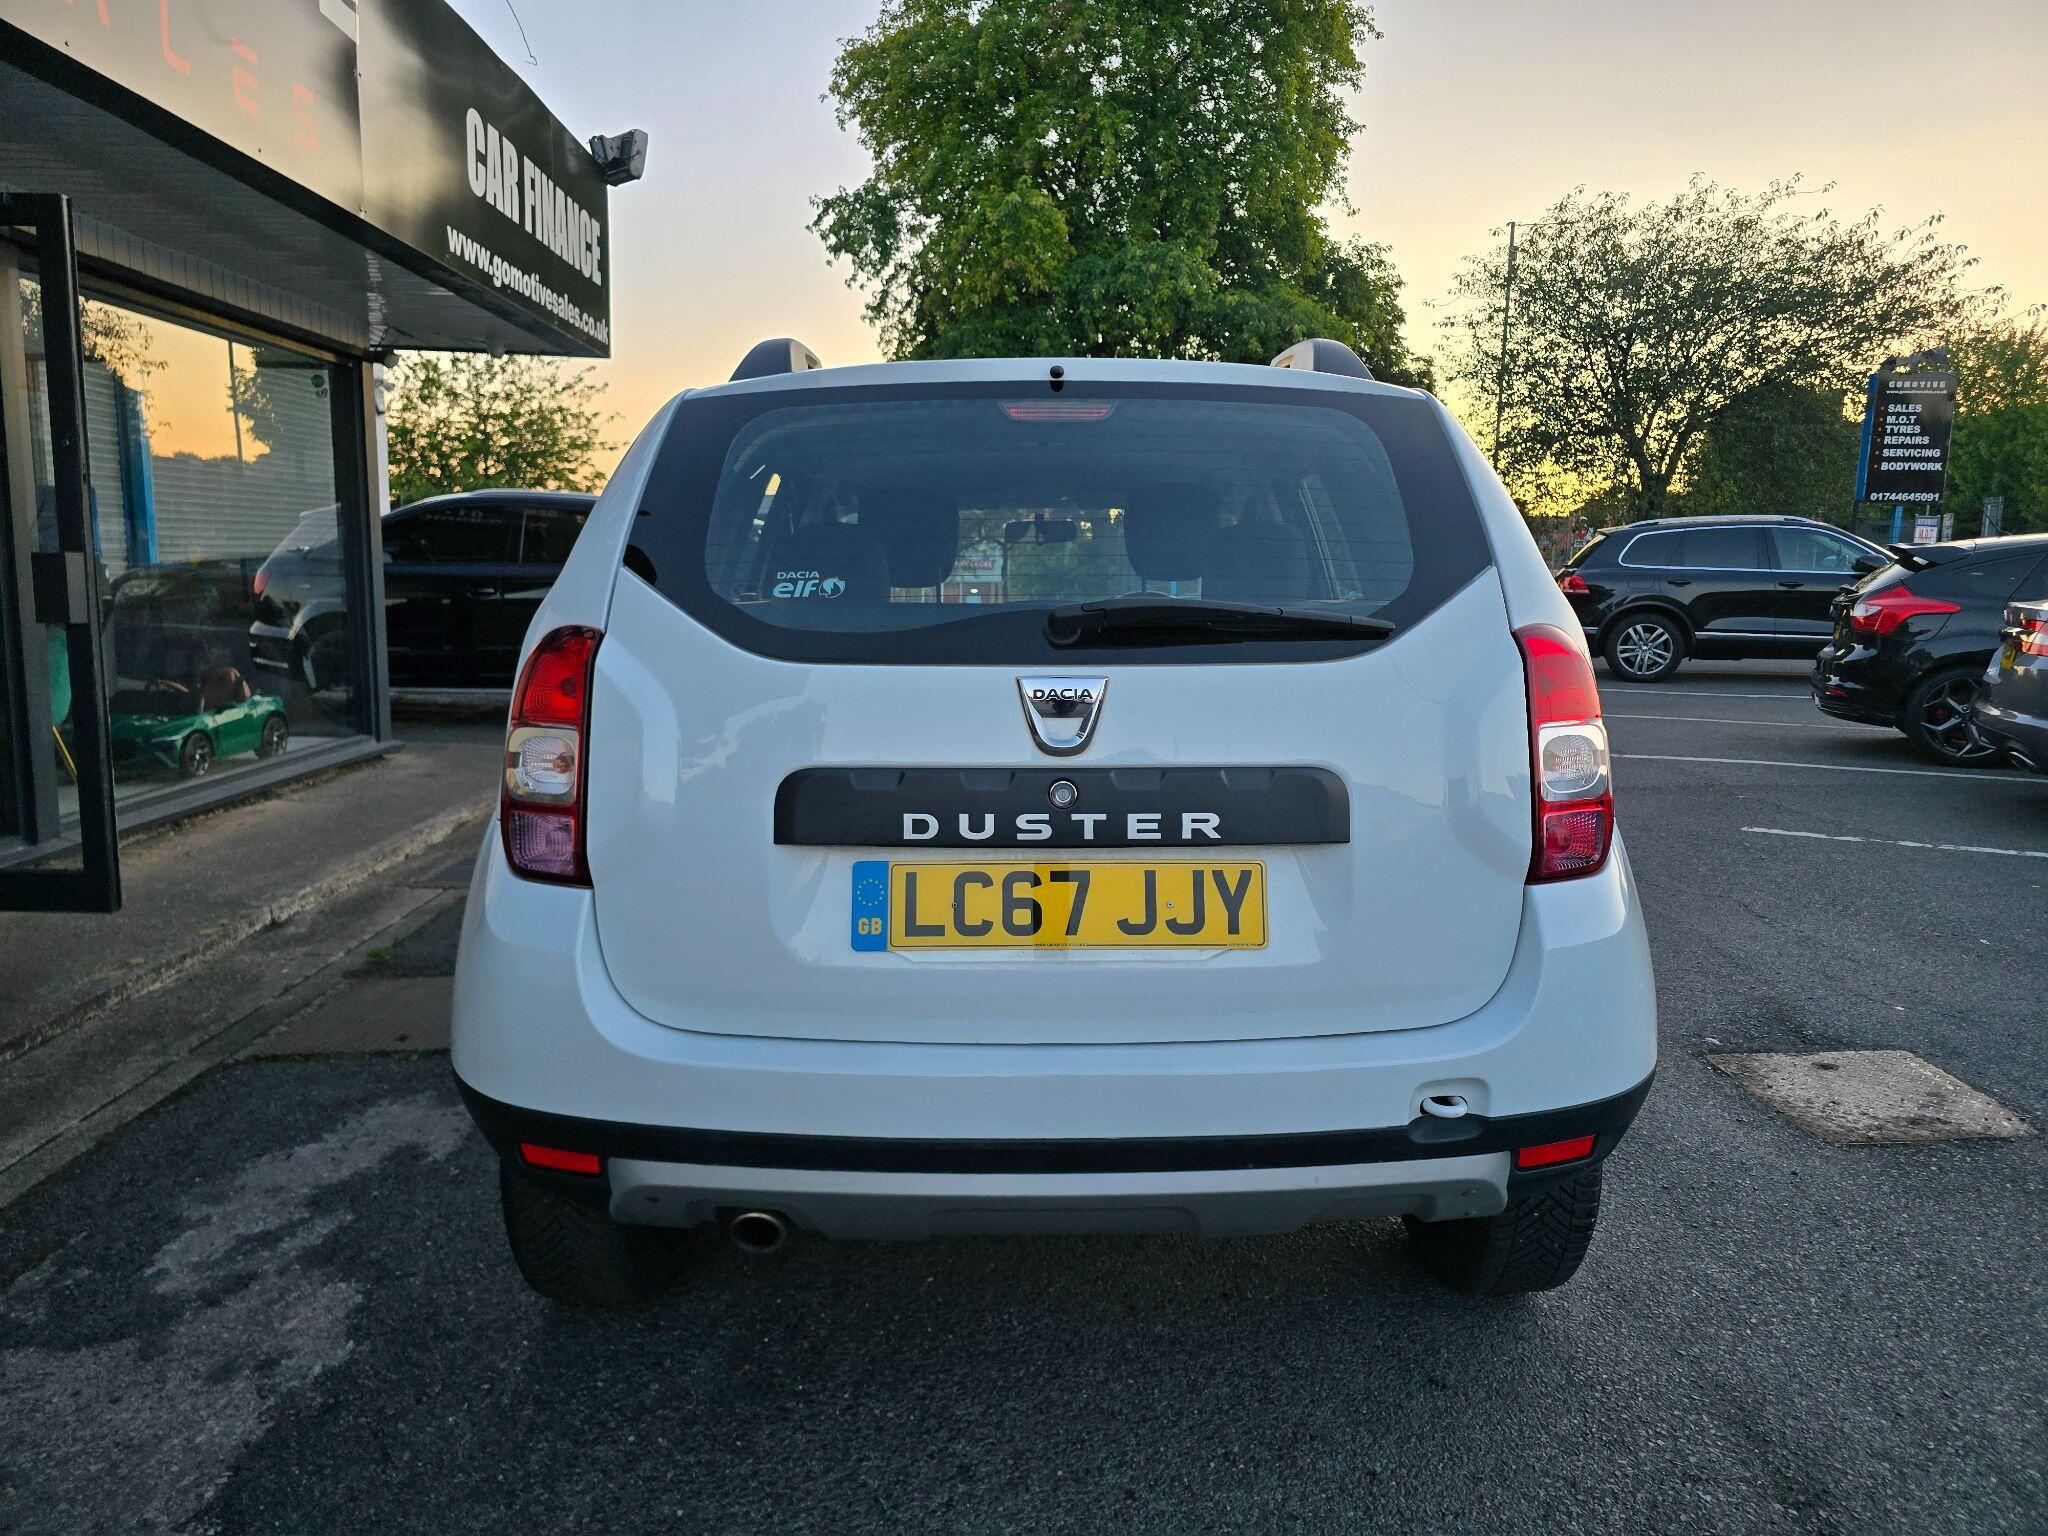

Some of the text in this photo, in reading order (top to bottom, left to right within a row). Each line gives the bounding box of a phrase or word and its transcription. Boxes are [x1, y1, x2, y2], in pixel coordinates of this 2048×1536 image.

[466, 107, 602, 287] CAR FINANCE
[446, 224, 609, 346] www.gomotivesales.co.uk
[1887, 404, 1922, 413] SALES
[1886, 415, 1917, 424] M.O.T
[1885, 425, 1921, 434] TYRES
[1883, 436, 1930, 445] REPAIRS
[1882, 449, 1941, 458] SERVICING
[1881, 462, 1943, 471] BODYWORK
[1870, 492, 1940, 501] 01744645091
[777, 571, 820, 579] DACIA
[772, 580, 820, 598] elf
[1032, 688, 1093, 700] DACIA
[902, 812, 1223, 840] DUSTER
[904, 869, 1253, 938] LC67 JJY
[857, 917, 883, 936] GB
